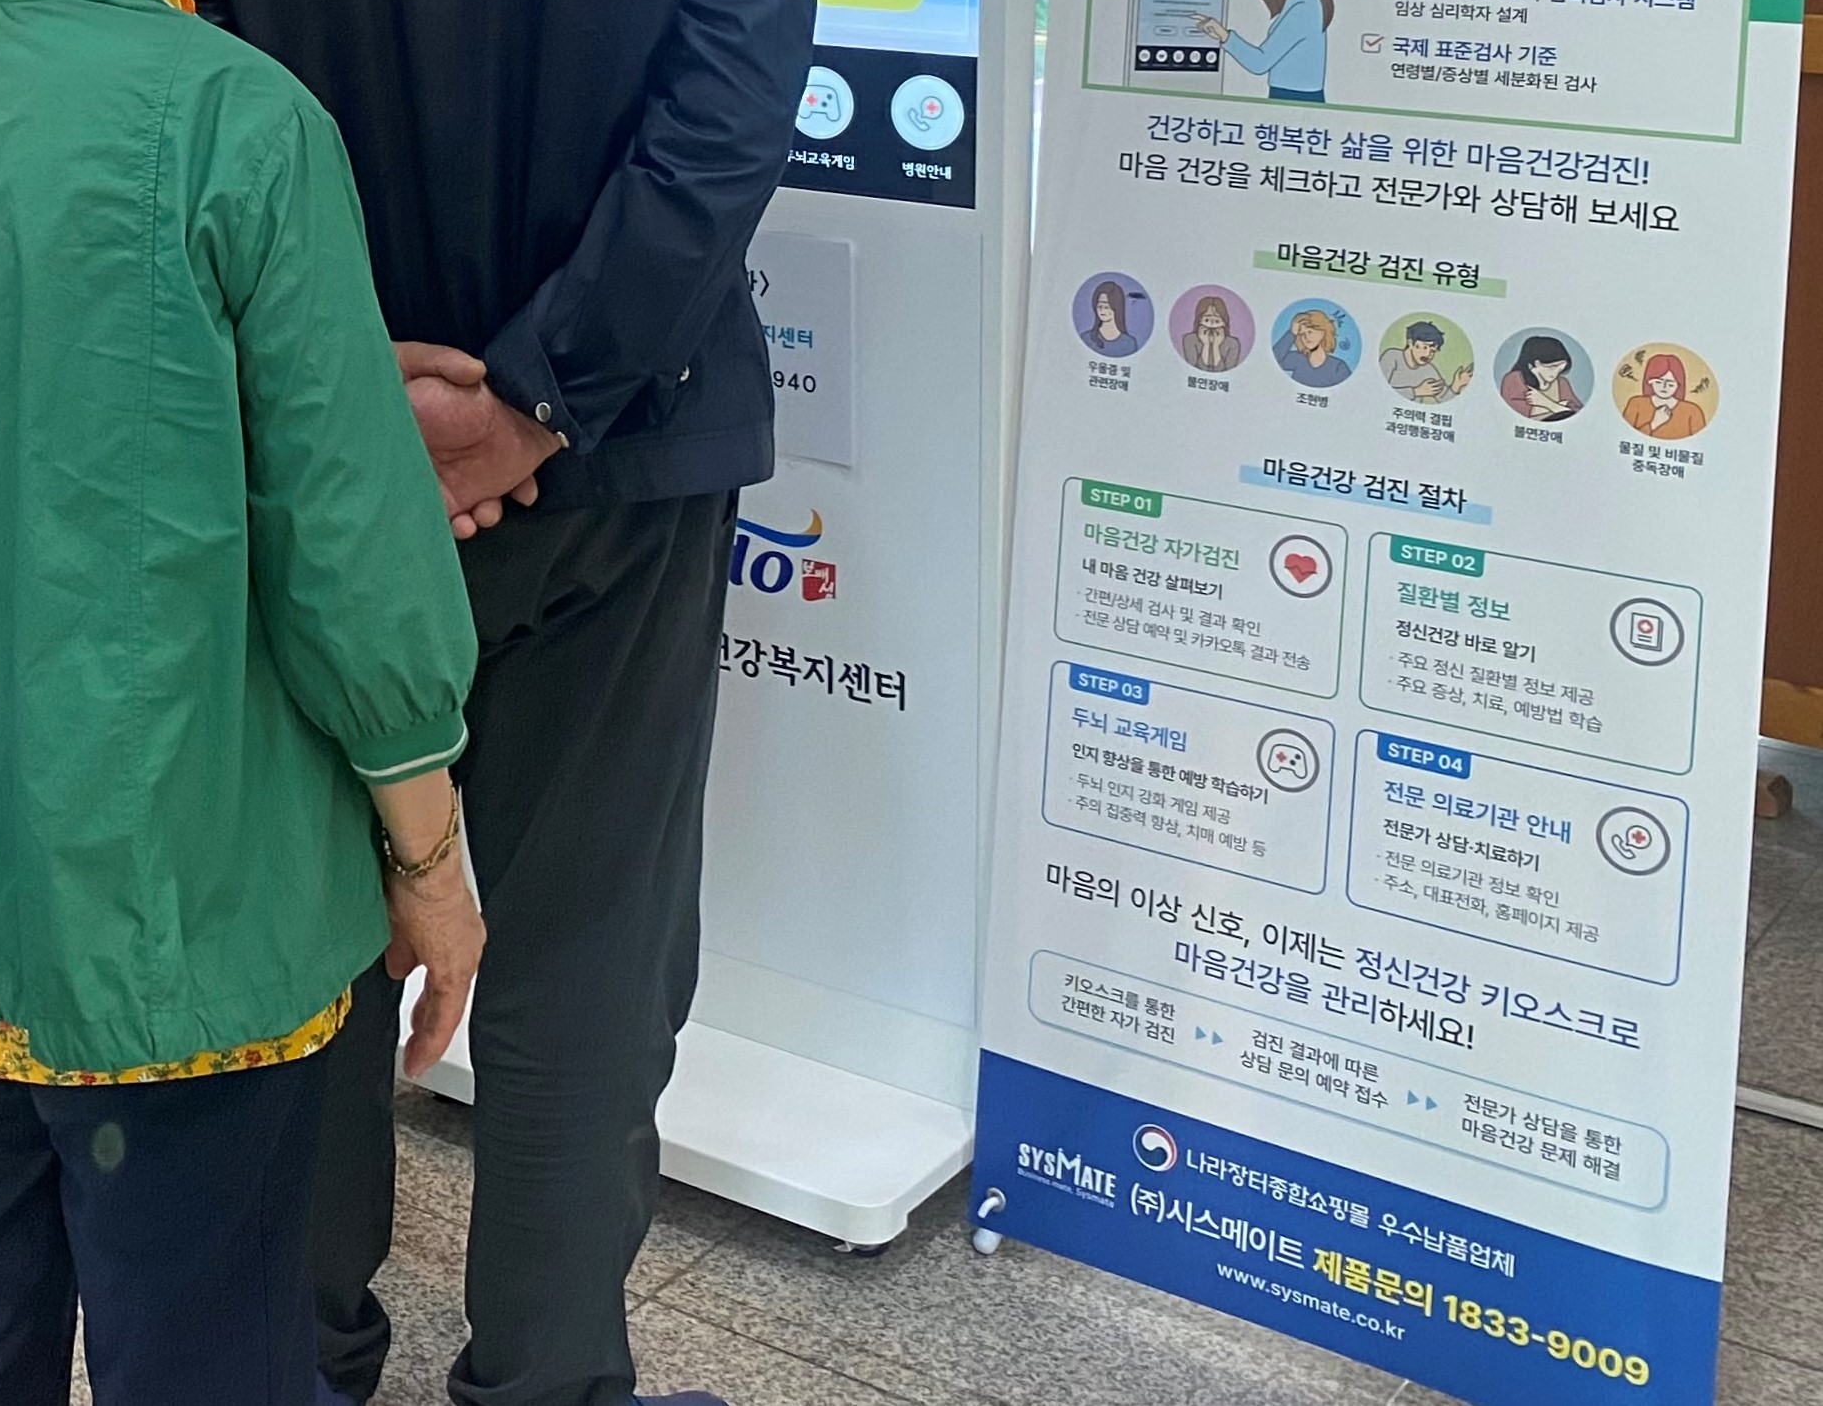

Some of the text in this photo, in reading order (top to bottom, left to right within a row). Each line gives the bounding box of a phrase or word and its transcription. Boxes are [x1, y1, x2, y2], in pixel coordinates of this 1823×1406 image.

[1393, 37, 1557, 66] 국제 표준검사 기준
[788, 150, 854, 170] 뇌교육게임
[902, 163, 951, 179] 병원안내
[1148, 115, 1648, 185] 건강하고 행복한 삶을 위한 마음건강검진!
[1120, 152, 1679, 231] 마음 건강을 체크하고 전문가와 상담해 보세요
[1278, 244, 1479, 288] 마음건강 검진 유형
[1515, 426, 1562, 444] 불면장애
[1264, 459, 1467, 514] 마음건강 검진 절차
[1633, 459, 1684, 478] 중독장애
[1091, 489, 1151, 511] STEP 01
[1084, 524, 1239, 570] 마음건강 자가검진
[1401, 545, 1475, 571] STEP 02
[1398, 582, 1510, 621] 질환별 정보
[1396, 620, 1535, 663] 정신건강 바로 알기
[1079, 673, 1142, 699] STEP 03
[1398, 652, 1594, 706] 주요 정신 질환별 정보 제공
[1072, 708, 1186, 752] 두뇌 교육게임
[1388, 743, 1462, 772] STEP 04
[1384, 781, 1571, 844] 전문 의료기관 안내
[1384, 819, 1540, 872] 전문가 상담·치료하기
[1047, 864, 1640, 1049] 마음의 이상 신호, 이제는 정신건강 키오스크로
[1062, 973, 1175, 1021] 키오스크를 통한
[1175, 941, 1473, 1049] 마음건강을 관리하세요!
[1252, 1030, 1379, 1083] 검진 결과에 따른
[1462, 1094, 1621, 1155] 전문가 상담을 통한
[1540, 1142, 1576, 1168] 문제
[1584, 1151, 1620, 1181] 해결
[1017, 1143, 1117, 1198] SYSMATE
[1186, 1150, 1370, 1229] 나라장터종합쇼핑몰
[1378, 1214, 1514, 1277] 우수납품업체
[1131, 1184, 1309, 1269] (주)시스메이트
[1313, 1248, 1433, 1320] 제품문의
[1443, 1295, 1649, 1385] 1833-9009
[1216, 1261, 1405, 1341] www.sysmate.co.kr
